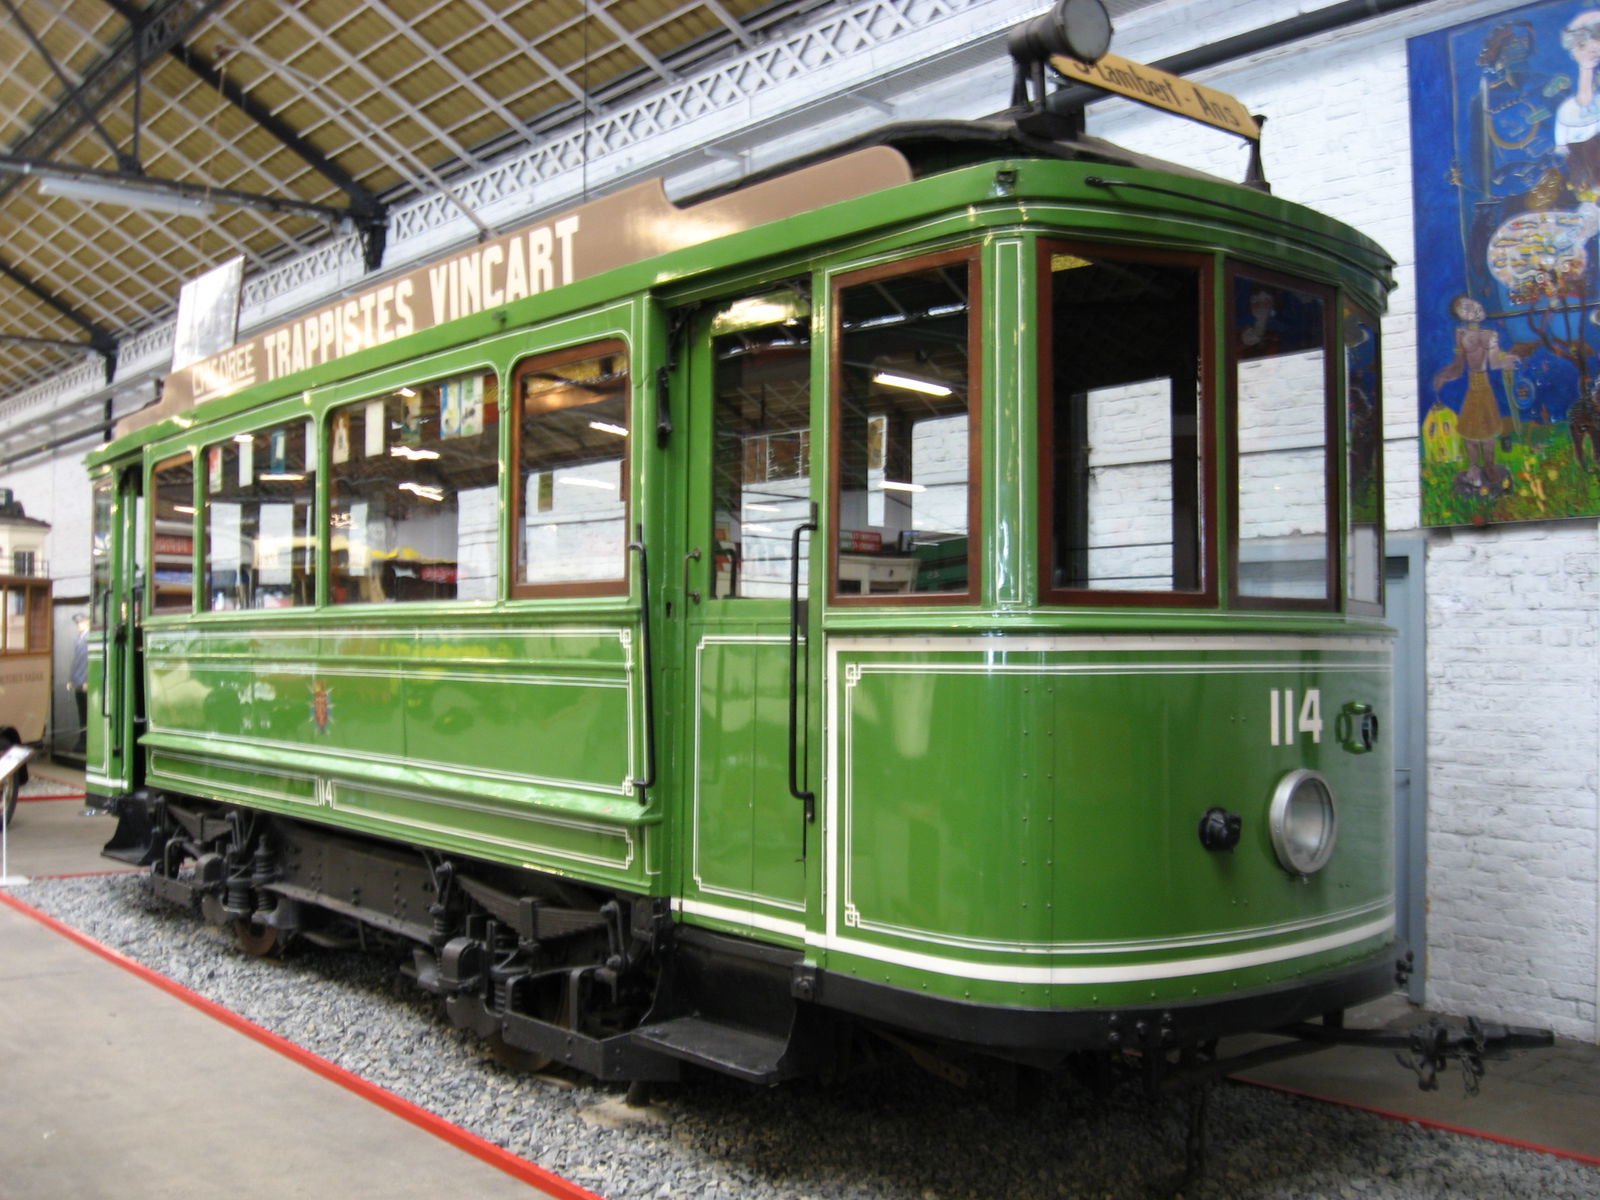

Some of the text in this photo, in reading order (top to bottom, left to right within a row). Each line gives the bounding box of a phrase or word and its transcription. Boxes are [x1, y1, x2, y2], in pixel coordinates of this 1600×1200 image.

[1097, 62, 1183, 108] Lambert
[1193, 87, 1241, 127] Ans
[263, 278, 416, 381] TRAPPISTES
[428, 215, 580, 326] VINCART
[1270, 688, 1323, 746] 114
